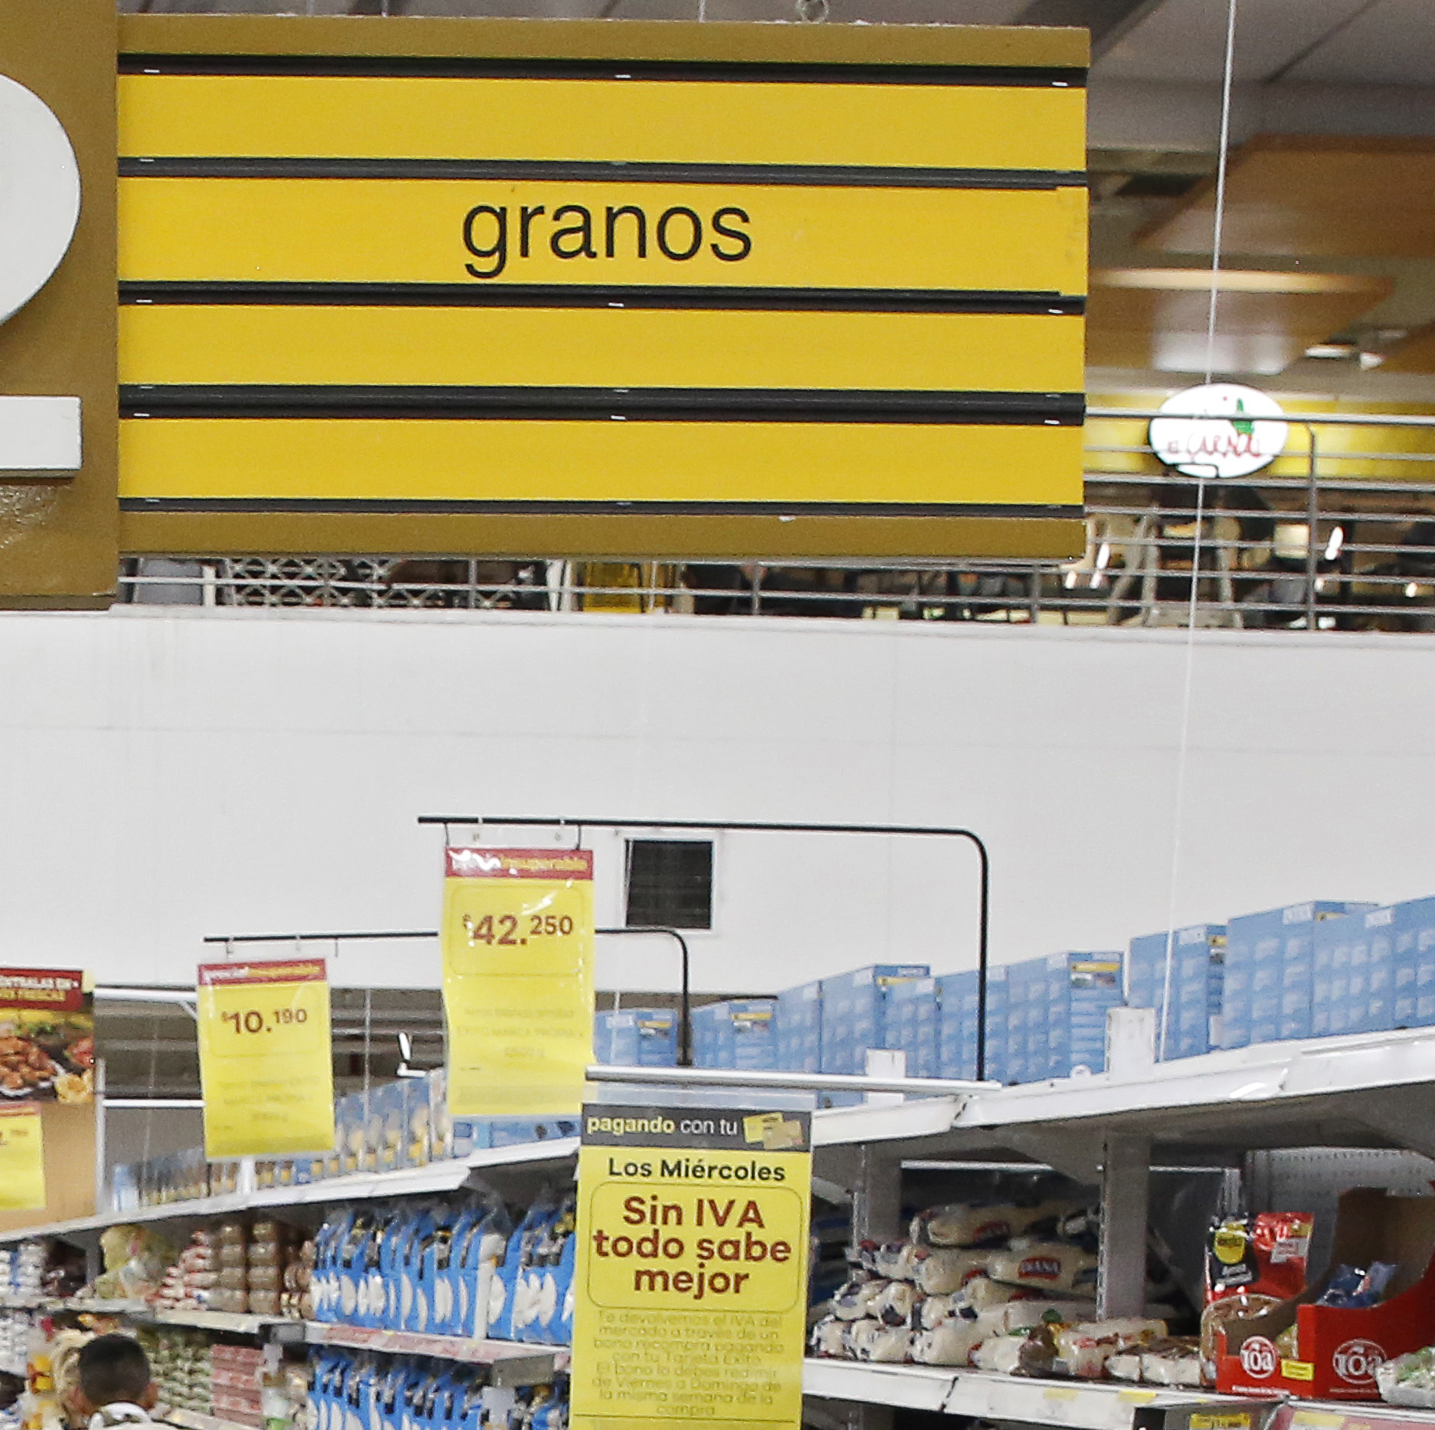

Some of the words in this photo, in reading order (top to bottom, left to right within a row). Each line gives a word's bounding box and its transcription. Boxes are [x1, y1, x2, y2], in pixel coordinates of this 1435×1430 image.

[461, 203, 754, 280] granos
[587, 1115, 676, 1136] pagando
[680, 1118, 715, 1135] con
[720, 1118, 738, 1136] tu
[608, 1157, 652, 1177] Los
[660, 1158, 786, 1182] Miércoles
[622, 1194, 683, 1226] Sin
[695, 1198, 765, 1229] IVA
[592, 1229, 685, 1259] todo
[696, 1231, 792, 1262] sabe
[634, 1261, 750, 1300] mejor
